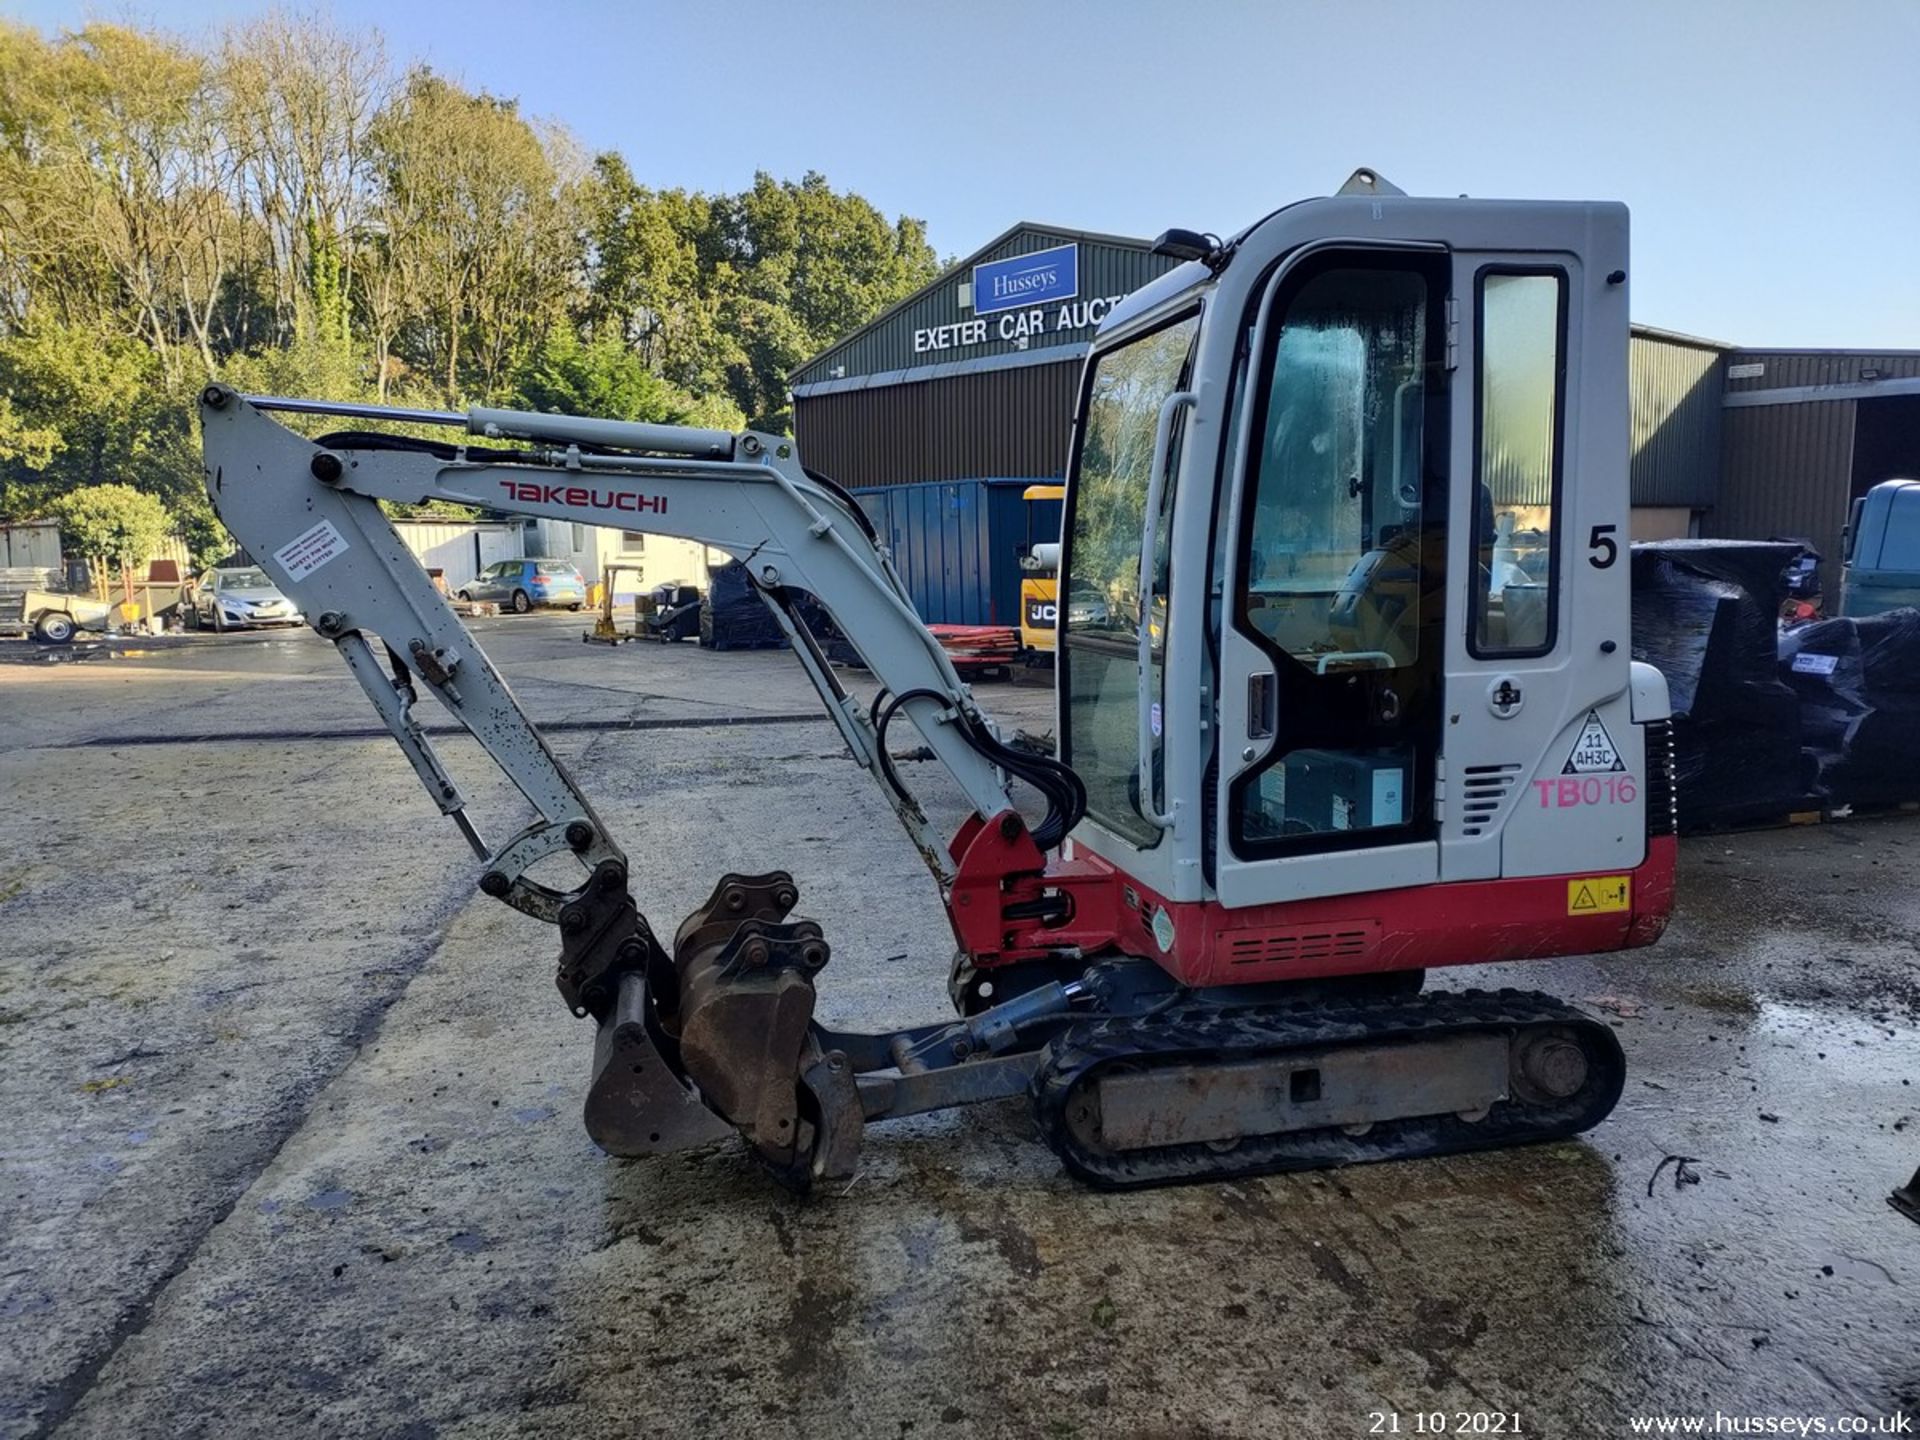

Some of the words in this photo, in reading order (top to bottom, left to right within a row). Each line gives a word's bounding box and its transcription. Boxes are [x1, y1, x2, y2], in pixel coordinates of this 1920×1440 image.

[994, 270, 1057, 296] Husseys
[915, 319, 987, 352] EXETER
[1000, 310, 1044, 339] CAR
[1057, 294, 1129, 331] AUCT
[1589, 524, 1617, 569] 5
[1586, 734, 1602, 748] 11
[1576, 750, 1610, 766] AH3C
[1533, 775, 1637, 808] TB016
